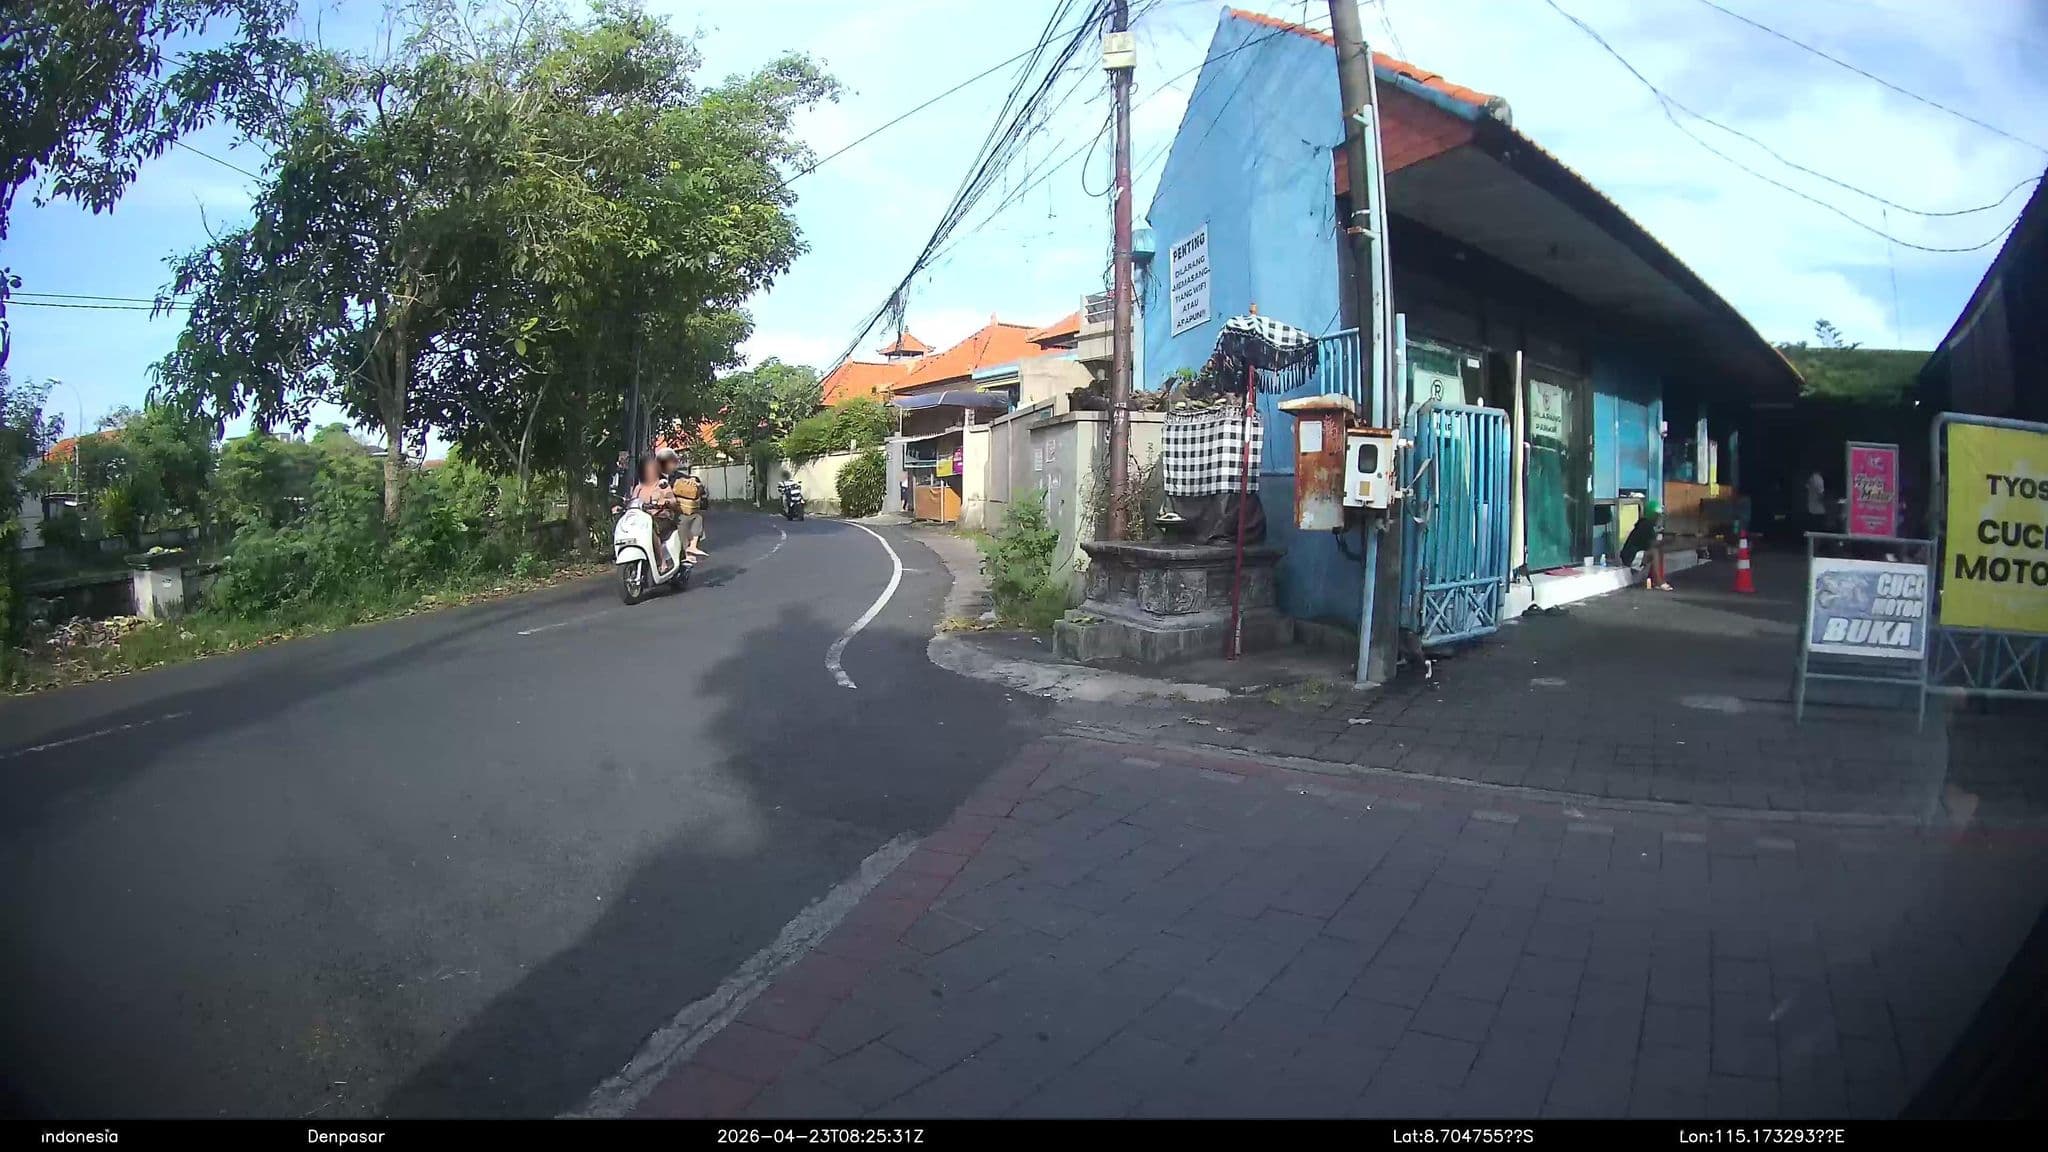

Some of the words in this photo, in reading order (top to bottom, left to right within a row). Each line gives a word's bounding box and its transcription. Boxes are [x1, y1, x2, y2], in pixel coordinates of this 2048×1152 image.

[1173, 232, 1205, 263] PENTING
[1175, 255, 1205, 278] DILARANG
[1175, 289, 1193, 303] TIANG
[1183, 298, 1199, 313] ATAU
[1877, 572, 1924, 598] CUCI
[1871, 598, 1923, 618] MOTOR
[1822, 617, 1912, 646] BUKA
